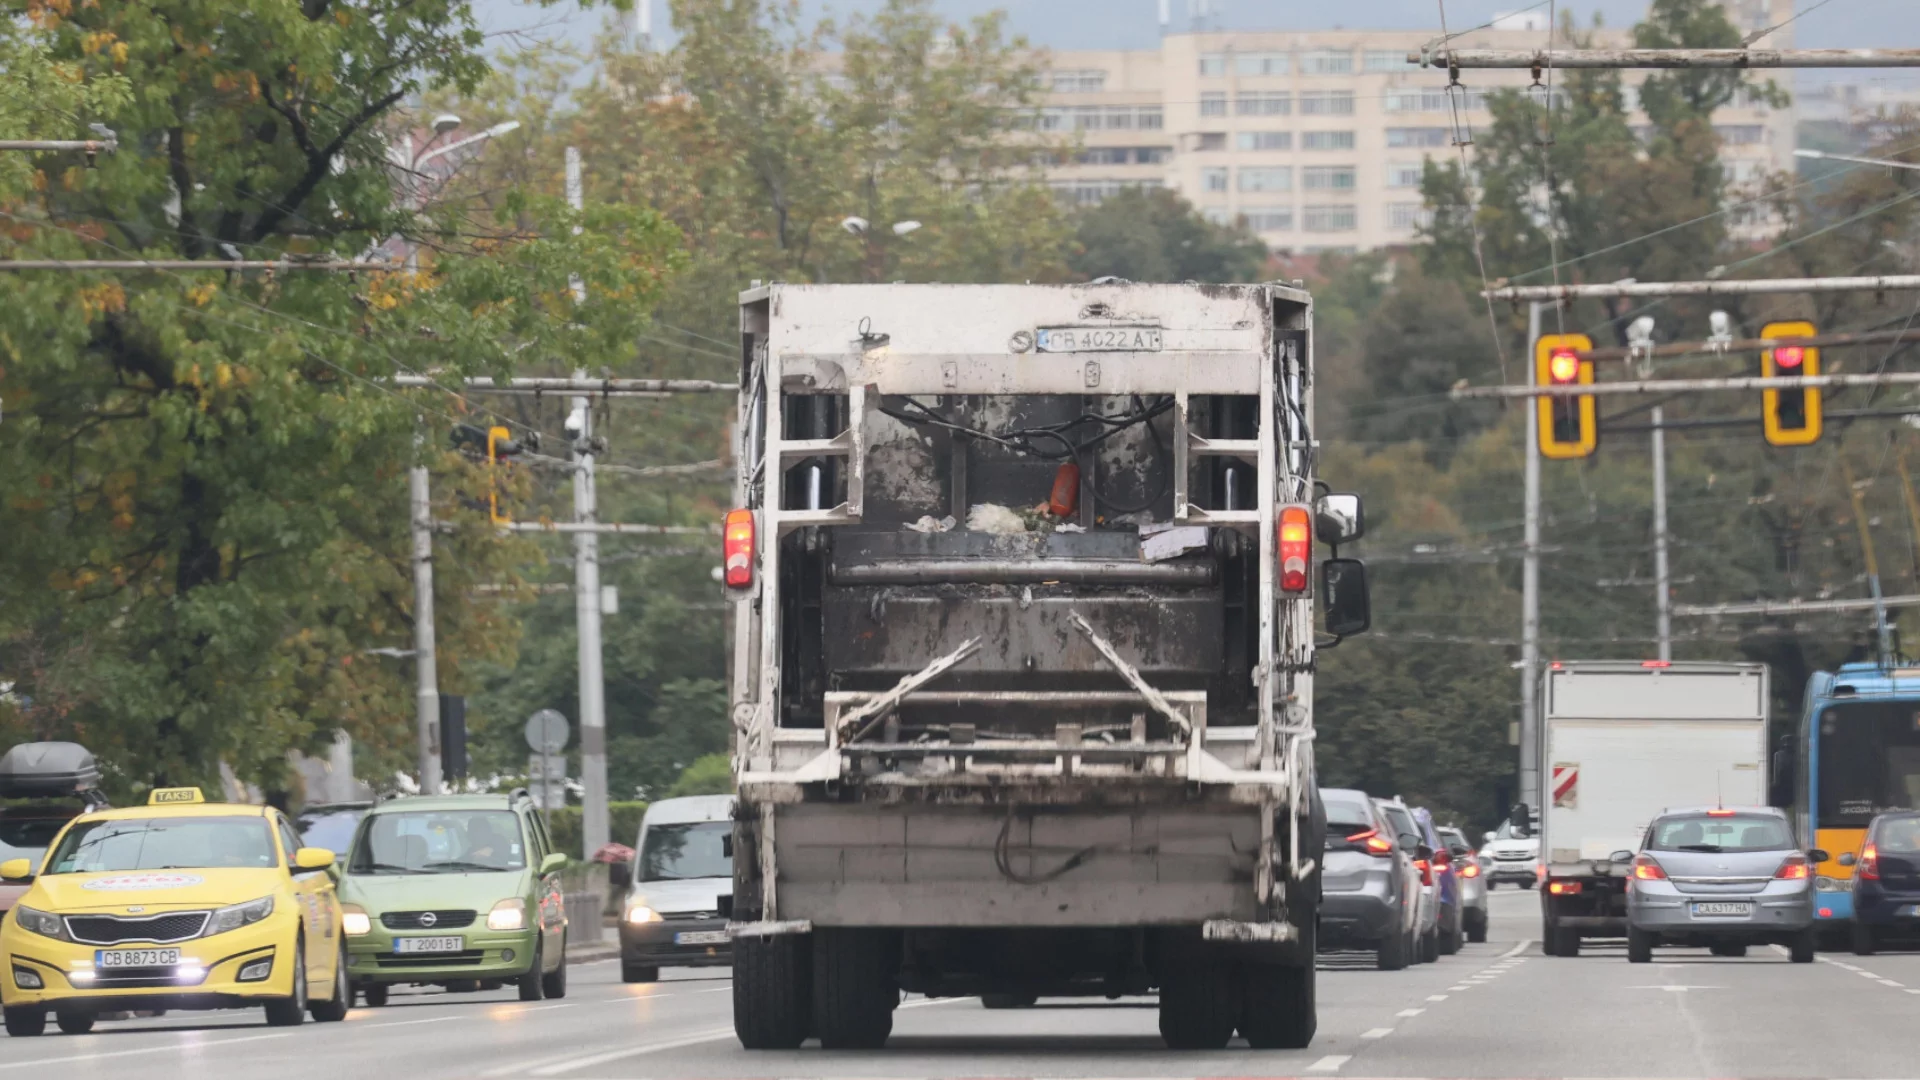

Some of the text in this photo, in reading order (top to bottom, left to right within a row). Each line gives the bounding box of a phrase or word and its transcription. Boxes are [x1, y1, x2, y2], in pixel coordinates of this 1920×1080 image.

[1081, 331, 1128, 348] 4022
[1133, 330, 1157, 348] AT
[405, 938, 460, 950] T 2001 BT
[105, 950, 177, 966] CB 8873 CB
